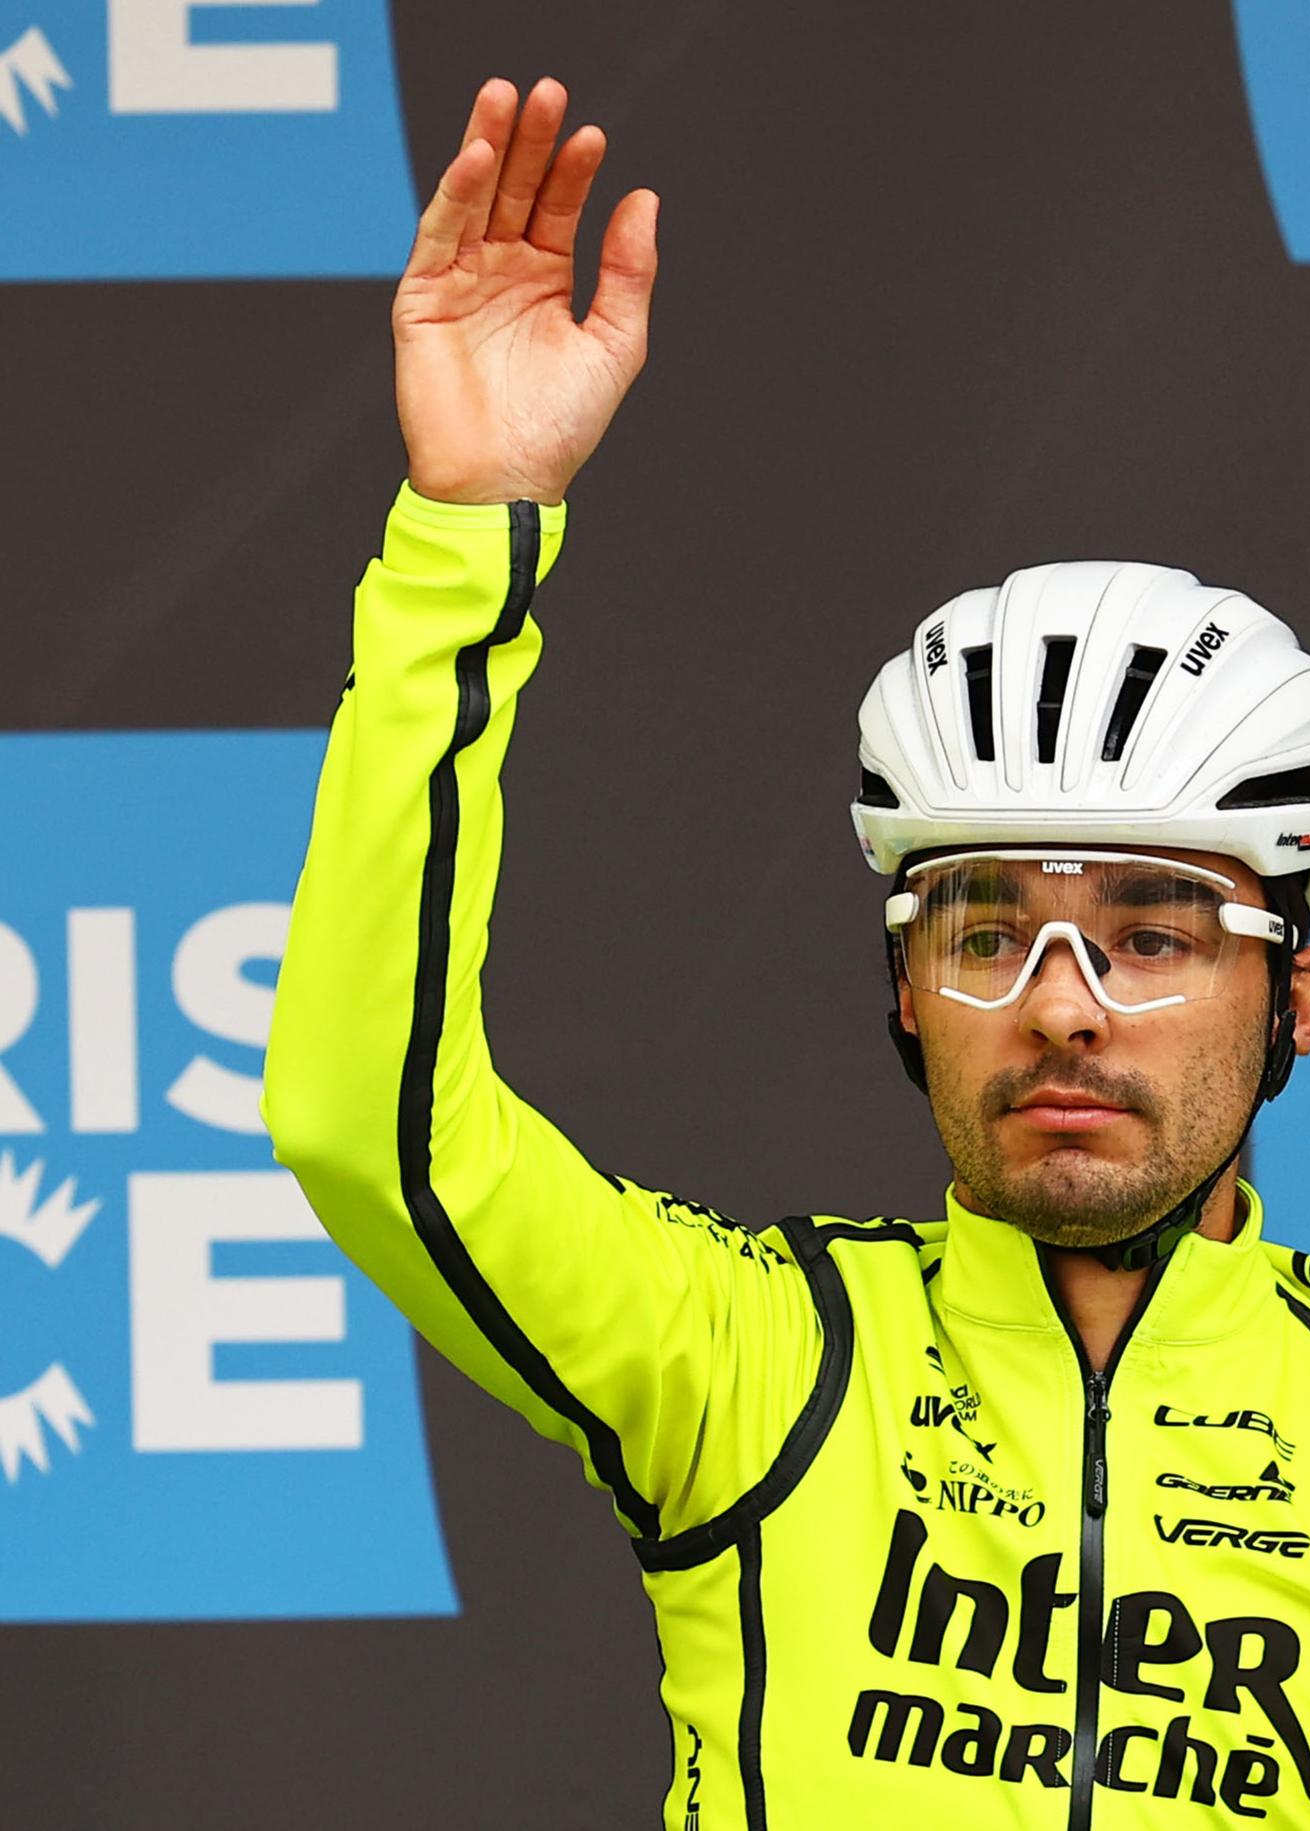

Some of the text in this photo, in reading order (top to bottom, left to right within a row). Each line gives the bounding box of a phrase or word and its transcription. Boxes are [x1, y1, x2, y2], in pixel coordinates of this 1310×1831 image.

[926, 620, 948, 677] uvex
[1180, 621, 1230, 677] uvex
[1042, 861, 1083, 875] uvex
[936, 1479, 1046, 1527] NIPPO
